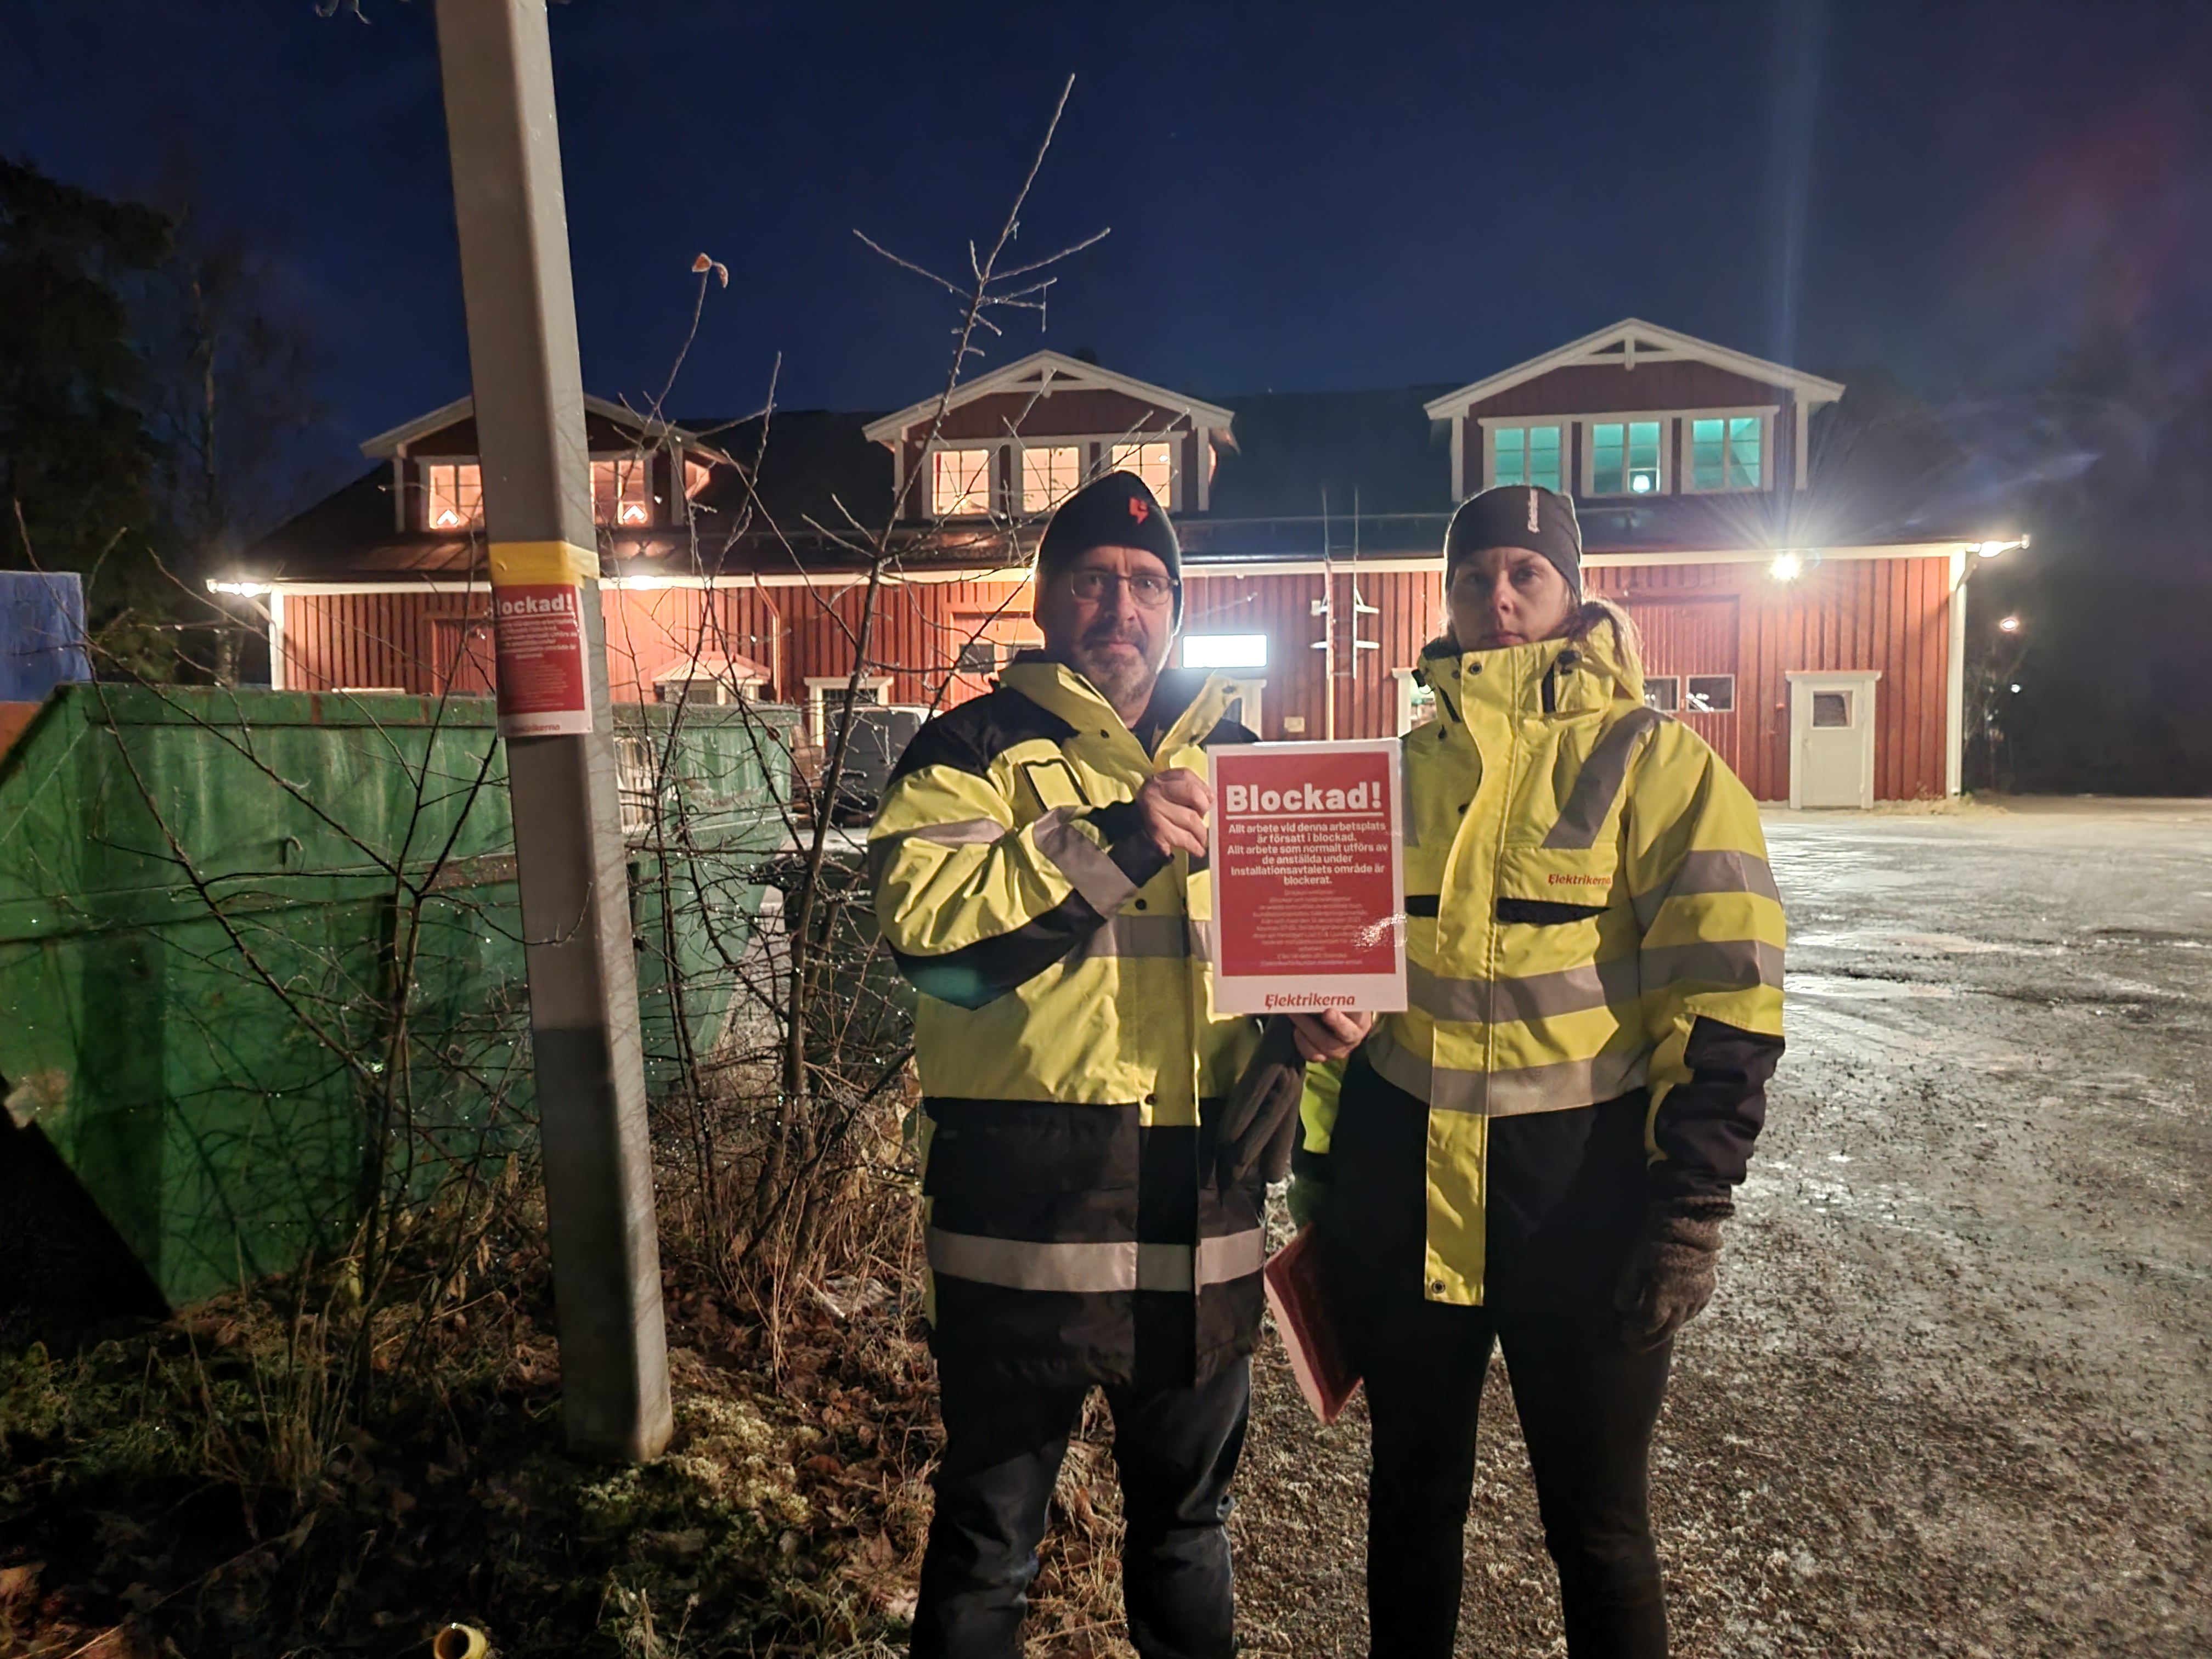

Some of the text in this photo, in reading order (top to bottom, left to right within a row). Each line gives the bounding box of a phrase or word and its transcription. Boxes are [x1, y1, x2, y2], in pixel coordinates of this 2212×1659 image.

[496, 592, 573, 616] lockad!
[1226, 781, 1381, 812] Blockad!
[1229, 821, 1386, 833] Allt arbete vid denna arbetsplats
[1257, 832, 1357, 843] är försatt i blockad.
[1227, 843, 1388, 854] Allt arbete som normalt utförs av
[1262, 853, 1353, 865] de anställda under
[1231, 863, 1385, 876] Installationsavtalets område är
[1284, 875, 1333, 885] blockerat.
[1265, 991, 1355, 1011] Elektrikerna
